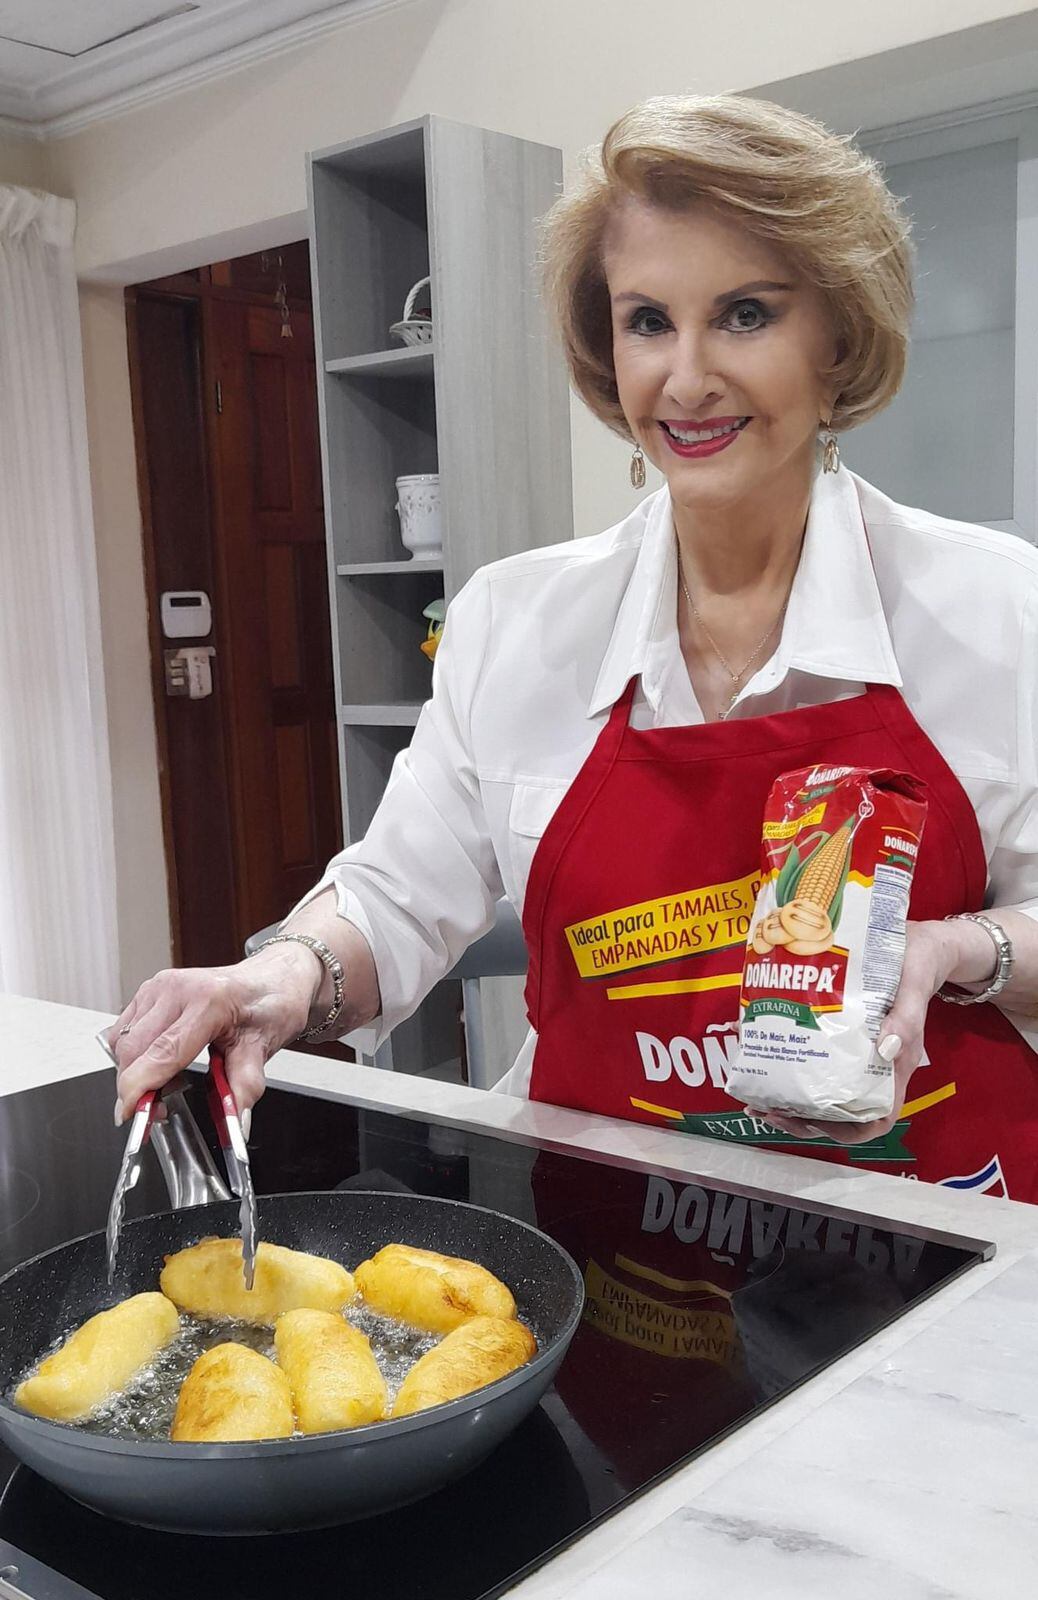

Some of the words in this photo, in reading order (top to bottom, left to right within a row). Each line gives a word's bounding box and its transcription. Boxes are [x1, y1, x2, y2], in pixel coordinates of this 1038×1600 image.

[571, 919, 610, 947] Ideal
[613, 911, 654, 943] para
[658, 889, 748, 923] TAMALES,
[592, 925, 703, 969] EMPANADAS
[707, 921, 719, 942] Y
[723, 916, 751, 938] TO
[745, 958, 834, 993] DOÑAREPA
[752, 1001, 800, 1017] EXTRAFINA
[635, 1022, 740, 1089] DOÑ
[744, 1029, 759, 1040] 100%
